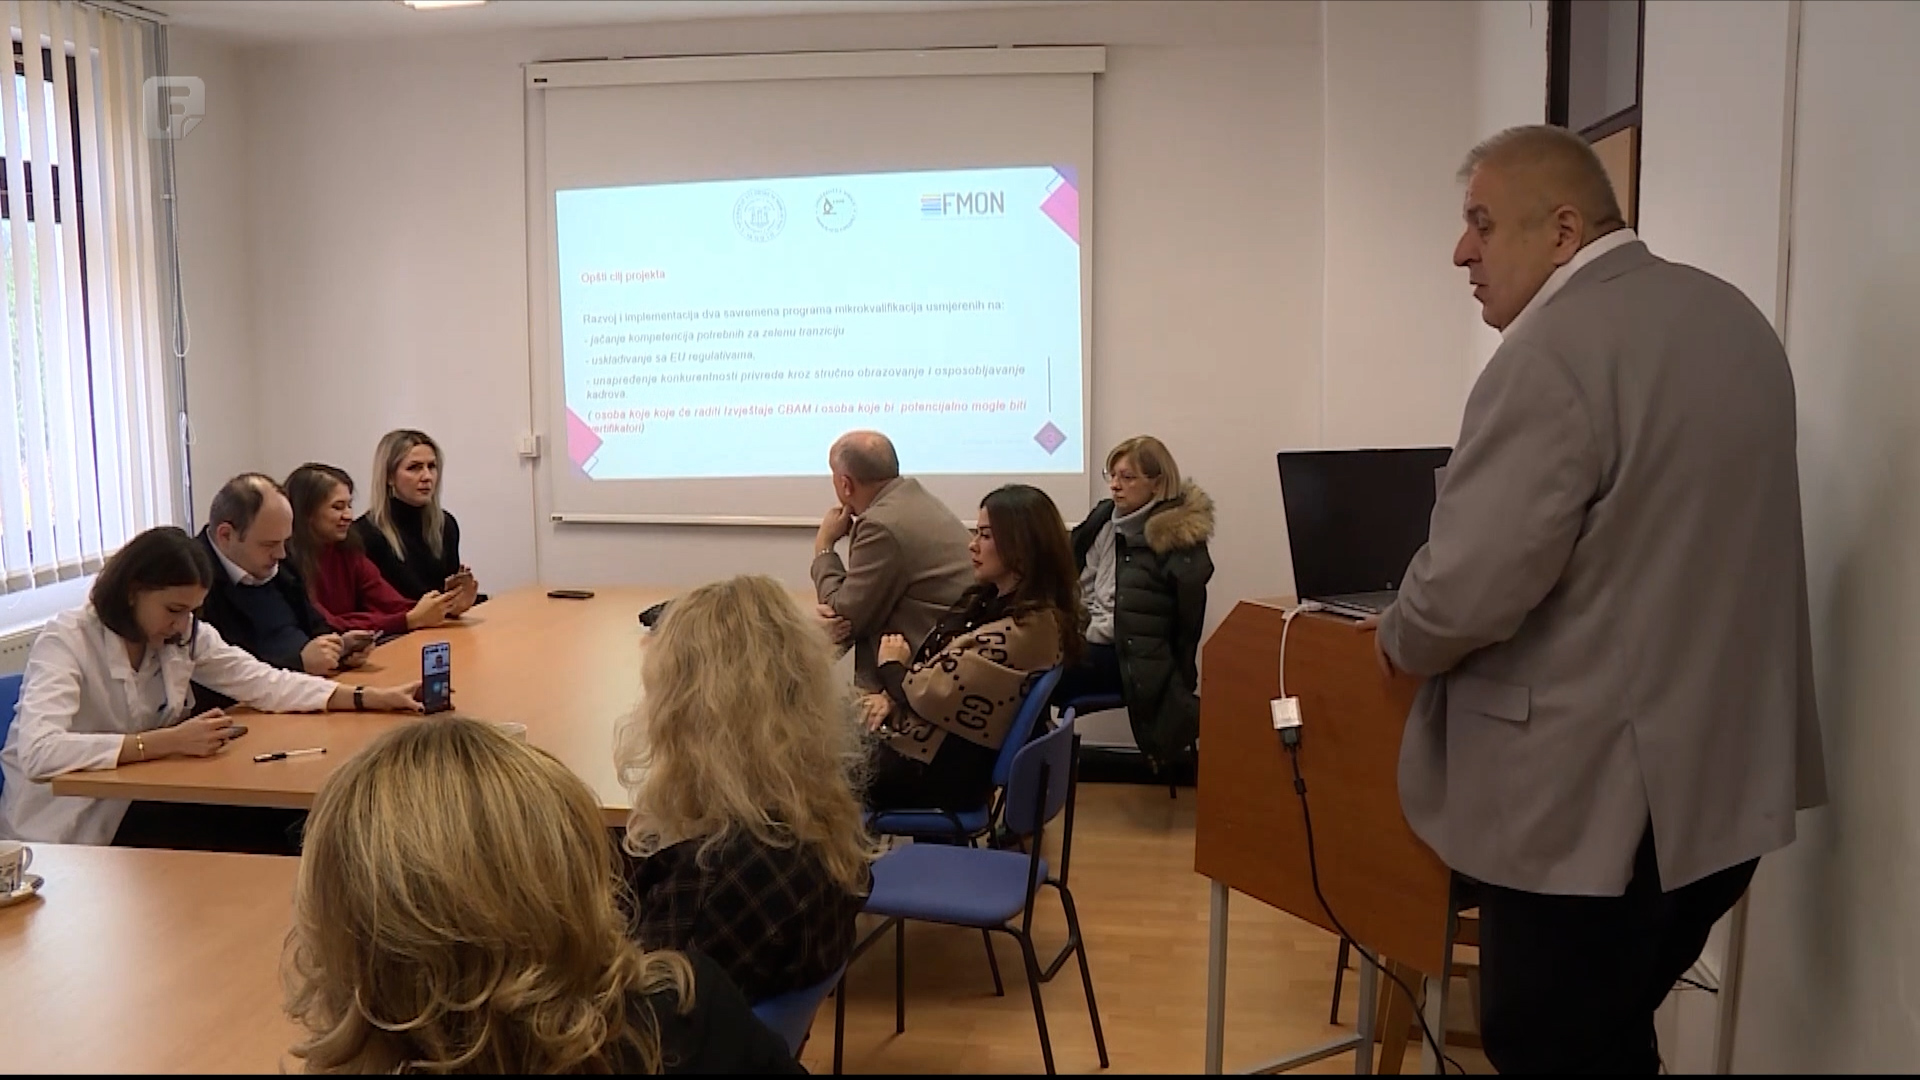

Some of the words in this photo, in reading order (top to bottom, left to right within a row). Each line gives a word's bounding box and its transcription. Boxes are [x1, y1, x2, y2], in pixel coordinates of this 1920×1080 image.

[942, 190, 1005, 216] FMON
[581, 272, 607, 285] Opšti
[610, 270, 623, 284] cilj
[625, 269, 667, 283] projekta
[583, 313, 618, 325] Razvoj
[625, 309, 700, 324] implementacija
[702, 308, 721, 319] dva
[723, 307, 780, 319] savremena
[782, 304, 833, 318] programa
[835, 302, 923, 315] mikrokvalifikacija
[926, 300, 985, 314] usmjerenih
[987, 301, 1005, 311] na:
[590, 333, 626, 347] jačanje
[628, 331, 695, 344] kompetencija
[696, 328, 745, 343] potrebnih
[747, 331, 760, 339] za
[762, 328, 797, 339] zelenu
[799, 325, 845, 339] tranziciju
[655, 354, 668, 363] sa
[670, 351, 687, 363] EU
[660, 371, 739, 384] konkurentnosti
[740, 370, 785, 383] privrede
[788, 369, 811, 380] kroz
[814, 367, 855, 379] stručno
[857, 364, 925, 379] obrazovanje
[935, 363, 1026, 378] osposobljavanje
[594, 410, 627, 420] osoba
[629, 408, 651, 421] koje
[654, 407, 676, 421] koje
[679, 407, 691, 418] će
[694, 405, 721, 417] raditi
[777, 403, 812, 415] CBAM
[821, 402, 855, 414] osoba
[857, 402, 881, 415] koje
[884, 402, 895, 412] bi
[900, 400, 969, 414] potencijalno
[971, 399, 1006, 412] mogle
[1009, 399, 1027, 411] biti
